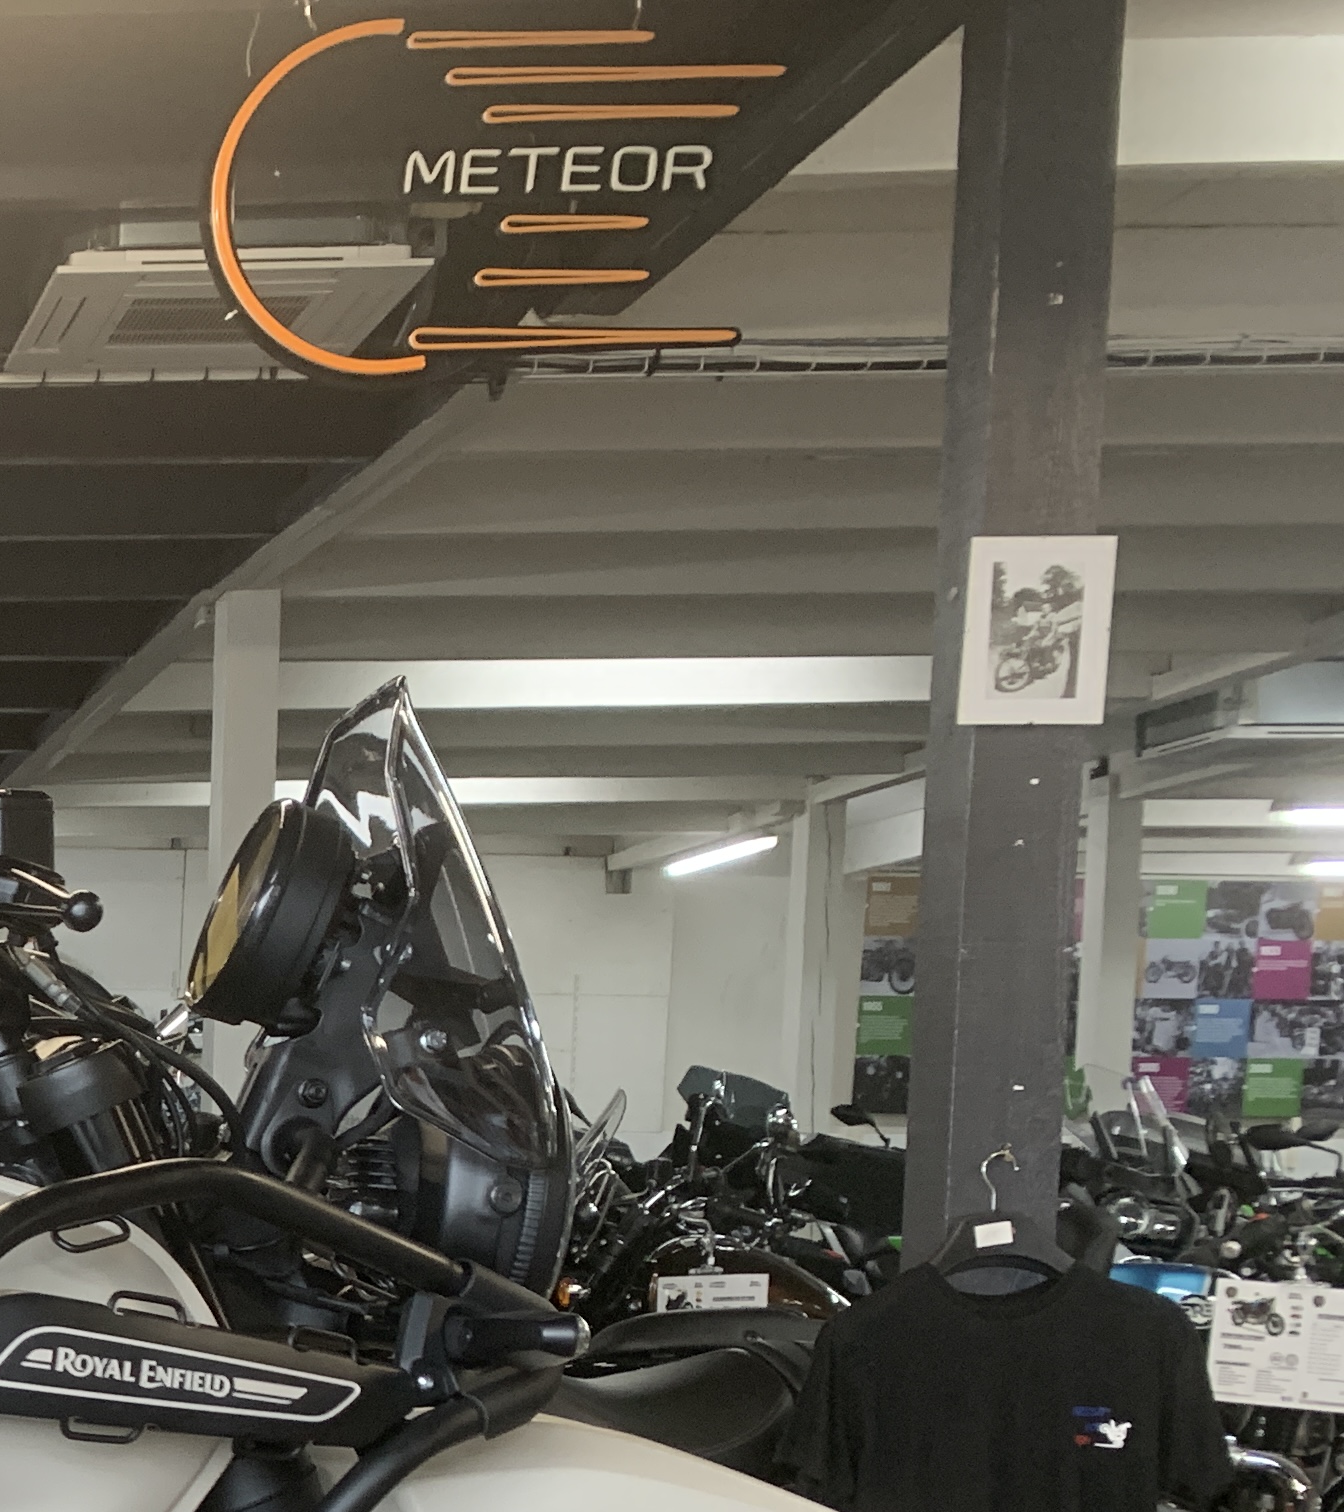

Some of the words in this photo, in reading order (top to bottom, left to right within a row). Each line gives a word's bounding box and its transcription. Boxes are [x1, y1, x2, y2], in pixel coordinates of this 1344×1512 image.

[403, 145, 714, 195] METEOR
[52, 1345, 136, 1384] ROYAL
[138, 1359, 232, 1398] ENFIELD
